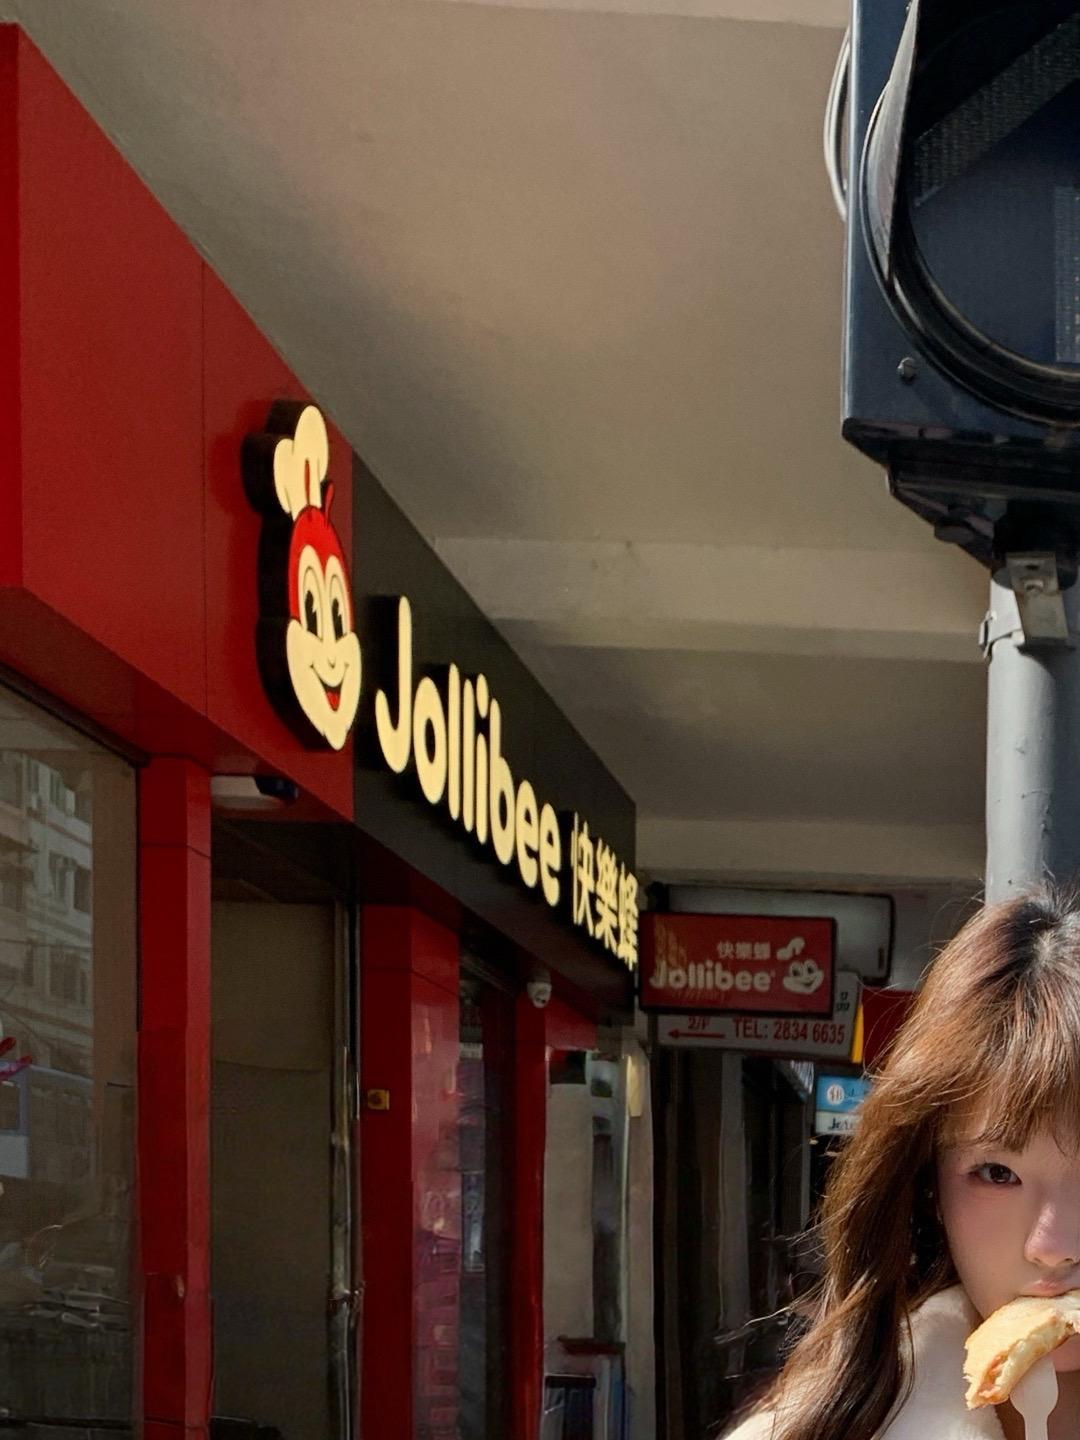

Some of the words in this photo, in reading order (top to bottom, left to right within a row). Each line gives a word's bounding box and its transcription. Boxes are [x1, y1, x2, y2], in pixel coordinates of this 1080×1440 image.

[375, 596, 561, 906] Jollibee
[571, 812, 638, 970] 快樂蜂
[650, 959, 771, 992] Jollibee
[732, 1018, 769, 1039] TEL:
[773, 1021, 808, 1041] 2834
[812, 1023, 845, 1045] 6635
